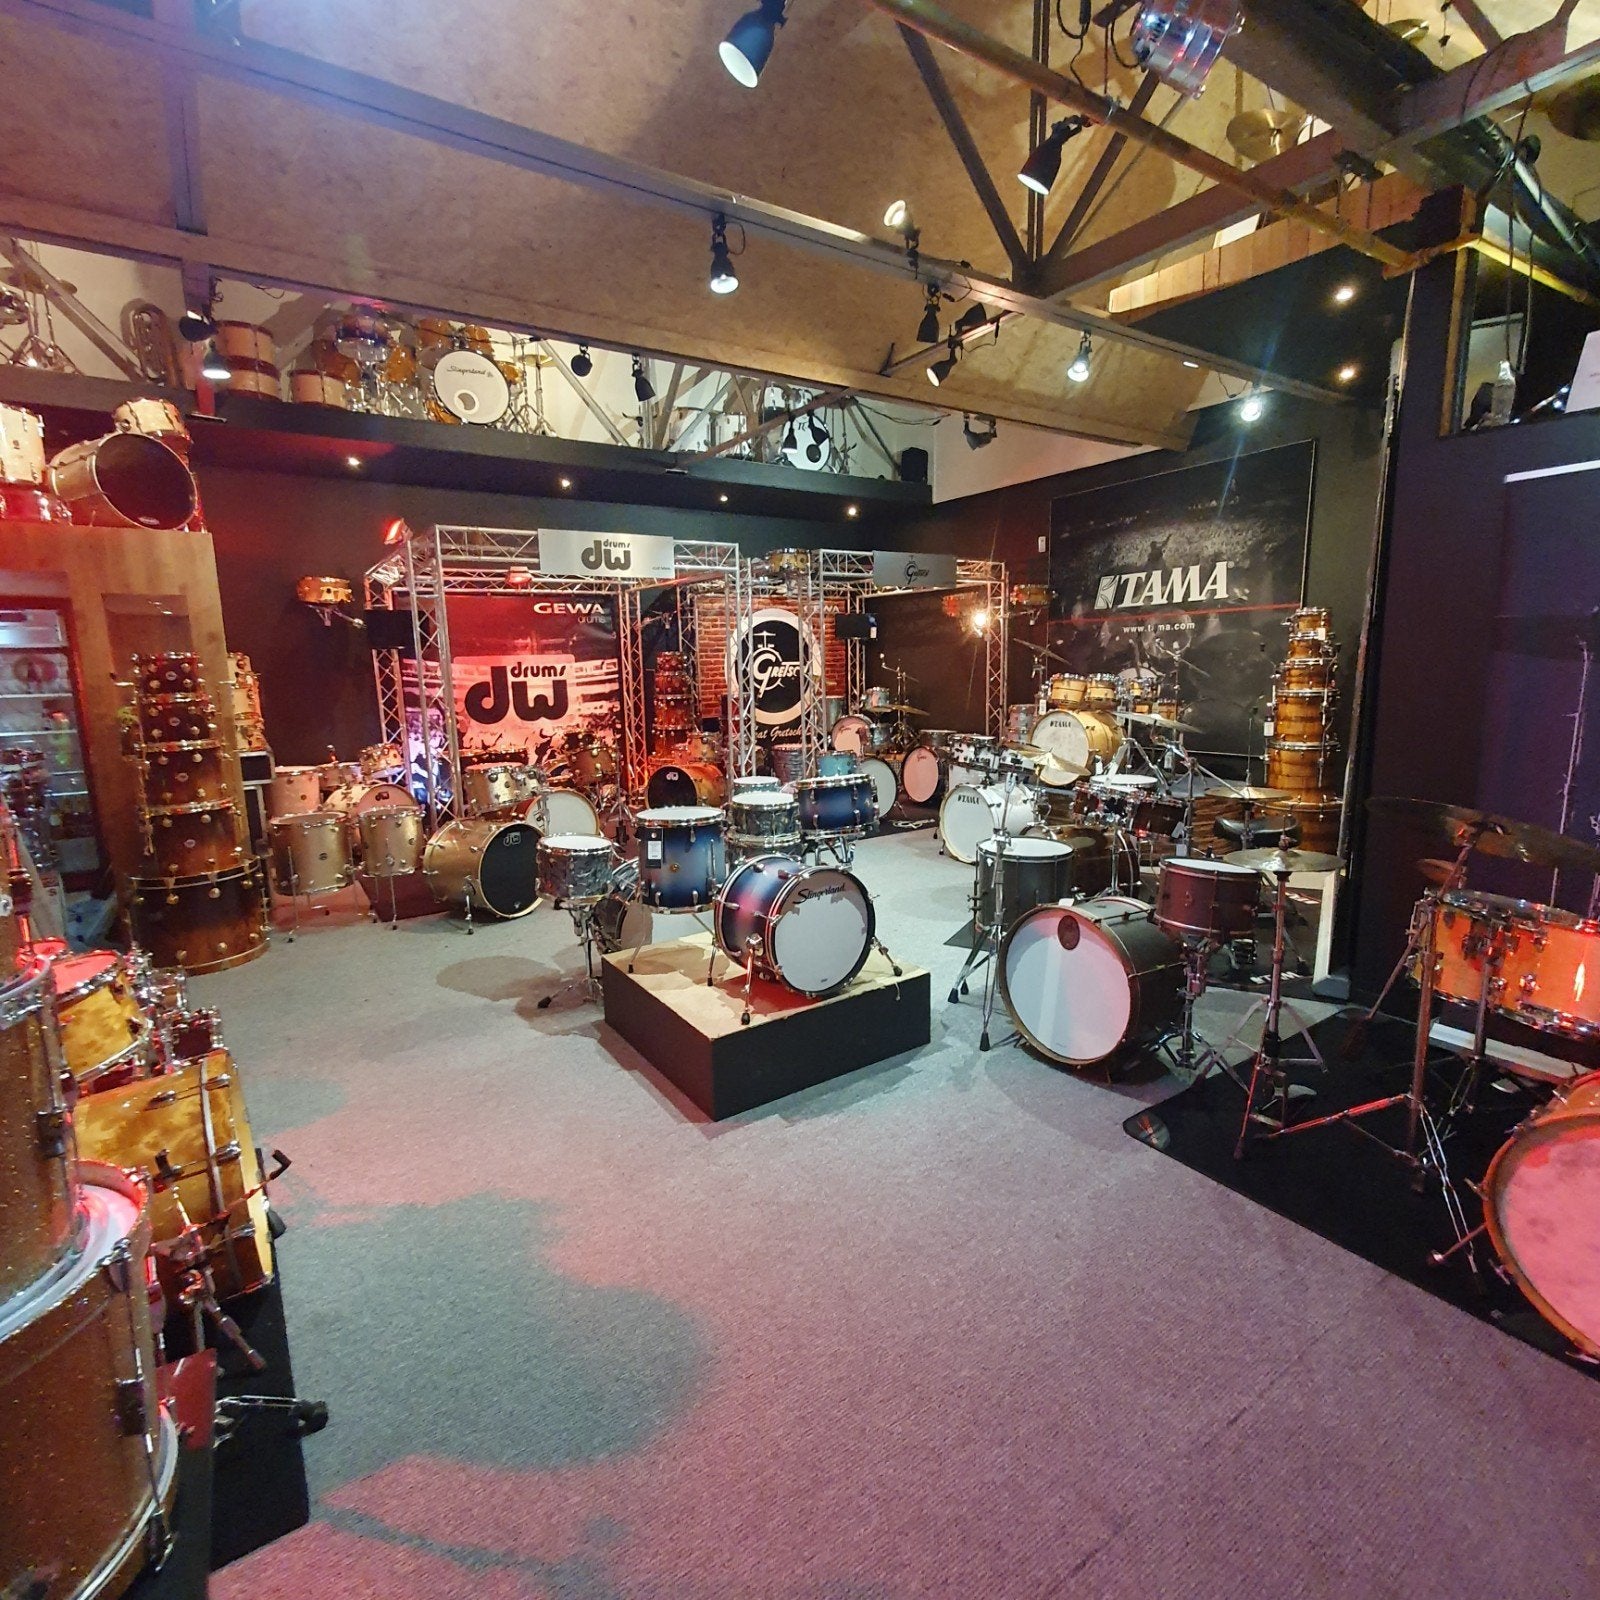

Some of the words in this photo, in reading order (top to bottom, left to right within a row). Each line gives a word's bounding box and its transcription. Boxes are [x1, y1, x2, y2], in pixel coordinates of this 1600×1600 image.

[581, 539, 631, 570] dw
[603, 538, 631, 548] drums
[1117, 561, 1228, 608] TAMA
[533, 602, 605, 614] GEWA
[510, 661, 567, 678] drums
[464, 665, 569, 725] dw
